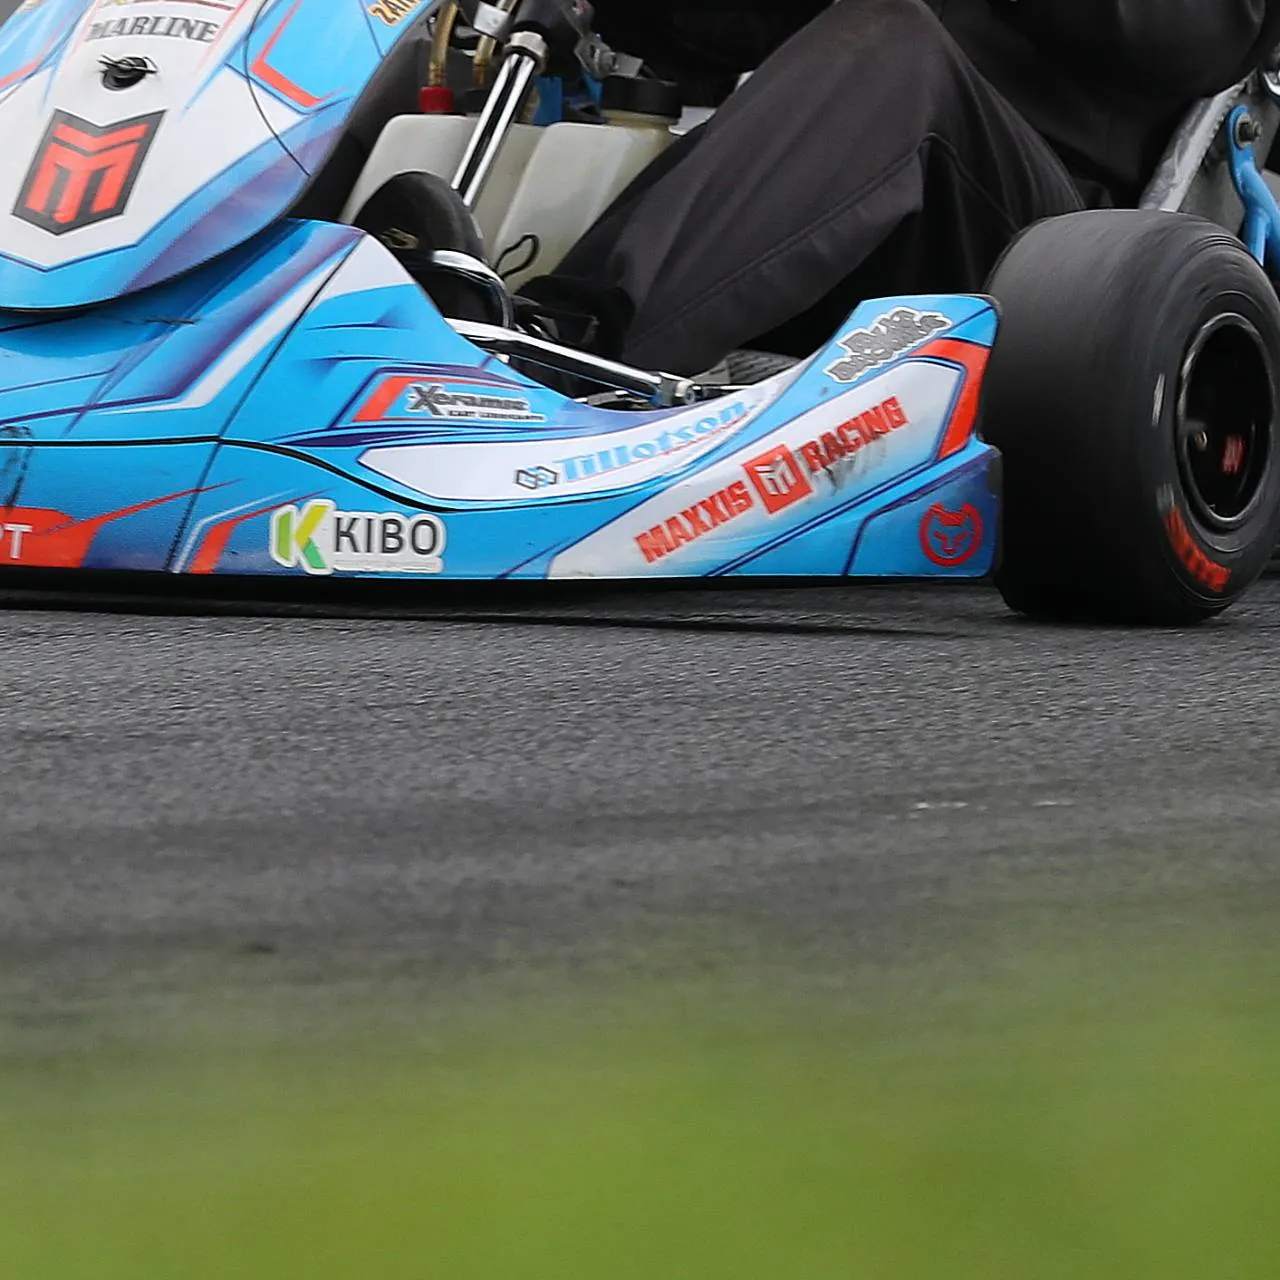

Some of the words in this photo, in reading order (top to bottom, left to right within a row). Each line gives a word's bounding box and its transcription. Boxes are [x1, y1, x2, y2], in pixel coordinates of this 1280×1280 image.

[634, 480, 754, 563] MAXXIS
[799, 396, 909, 472] RACING
[335, 516, 438, 556] KIBO
